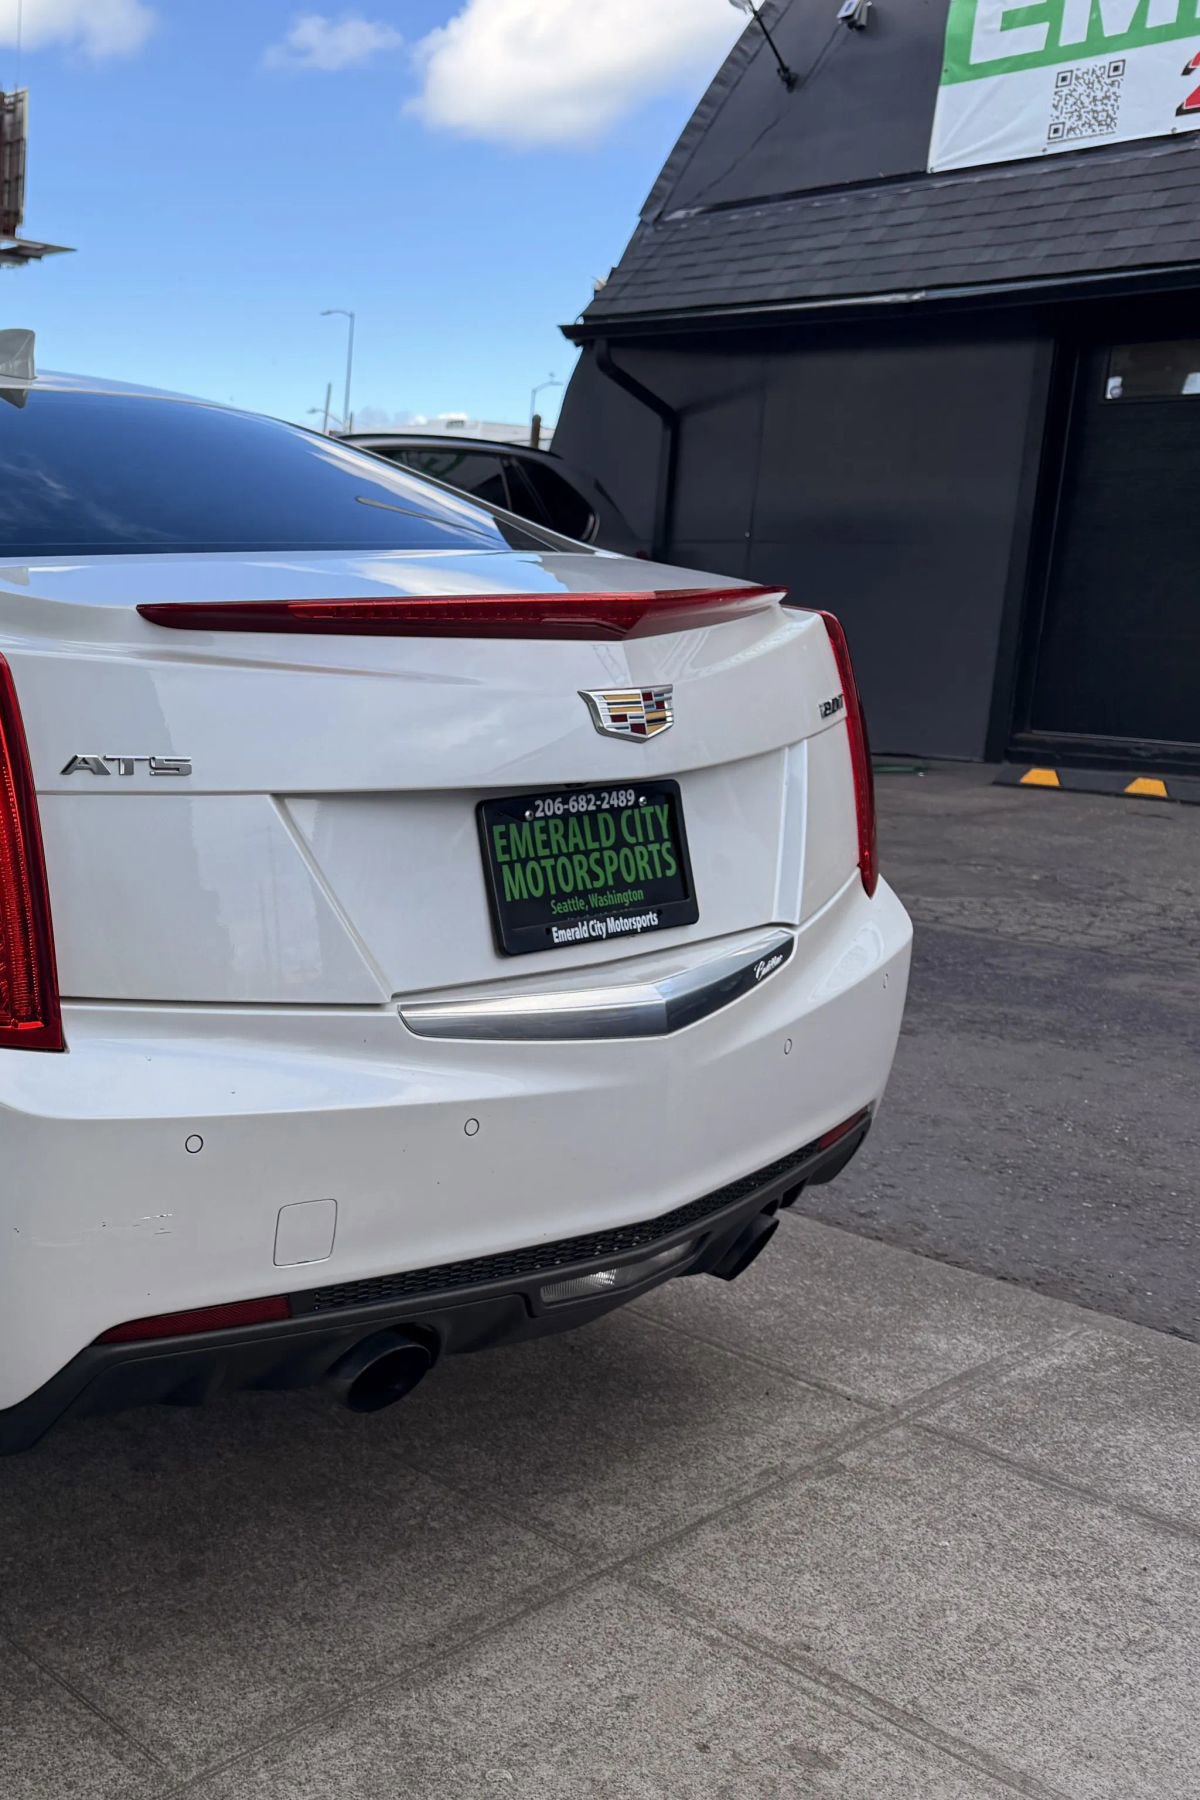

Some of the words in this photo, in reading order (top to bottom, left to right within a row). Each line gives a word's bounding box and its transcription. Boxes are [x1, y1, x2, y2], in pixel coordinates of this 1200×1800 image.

[59, 754, 192, 776] ATS
[534, 789, 636, 818] 206-682-2489
[492, 812, 616, 863] EMERALD
[620, 803, 670, 844] CITY
[501, 841, 678, 902] MOTORSPORTS
[550, 896, 589, 915] Seattle,
[588, 888, 645, 908] Washington
[551, 921, 590, 943] Emerald
[589, 919, 607, 939] City
[606, 911, 659, 933] Motorsports
